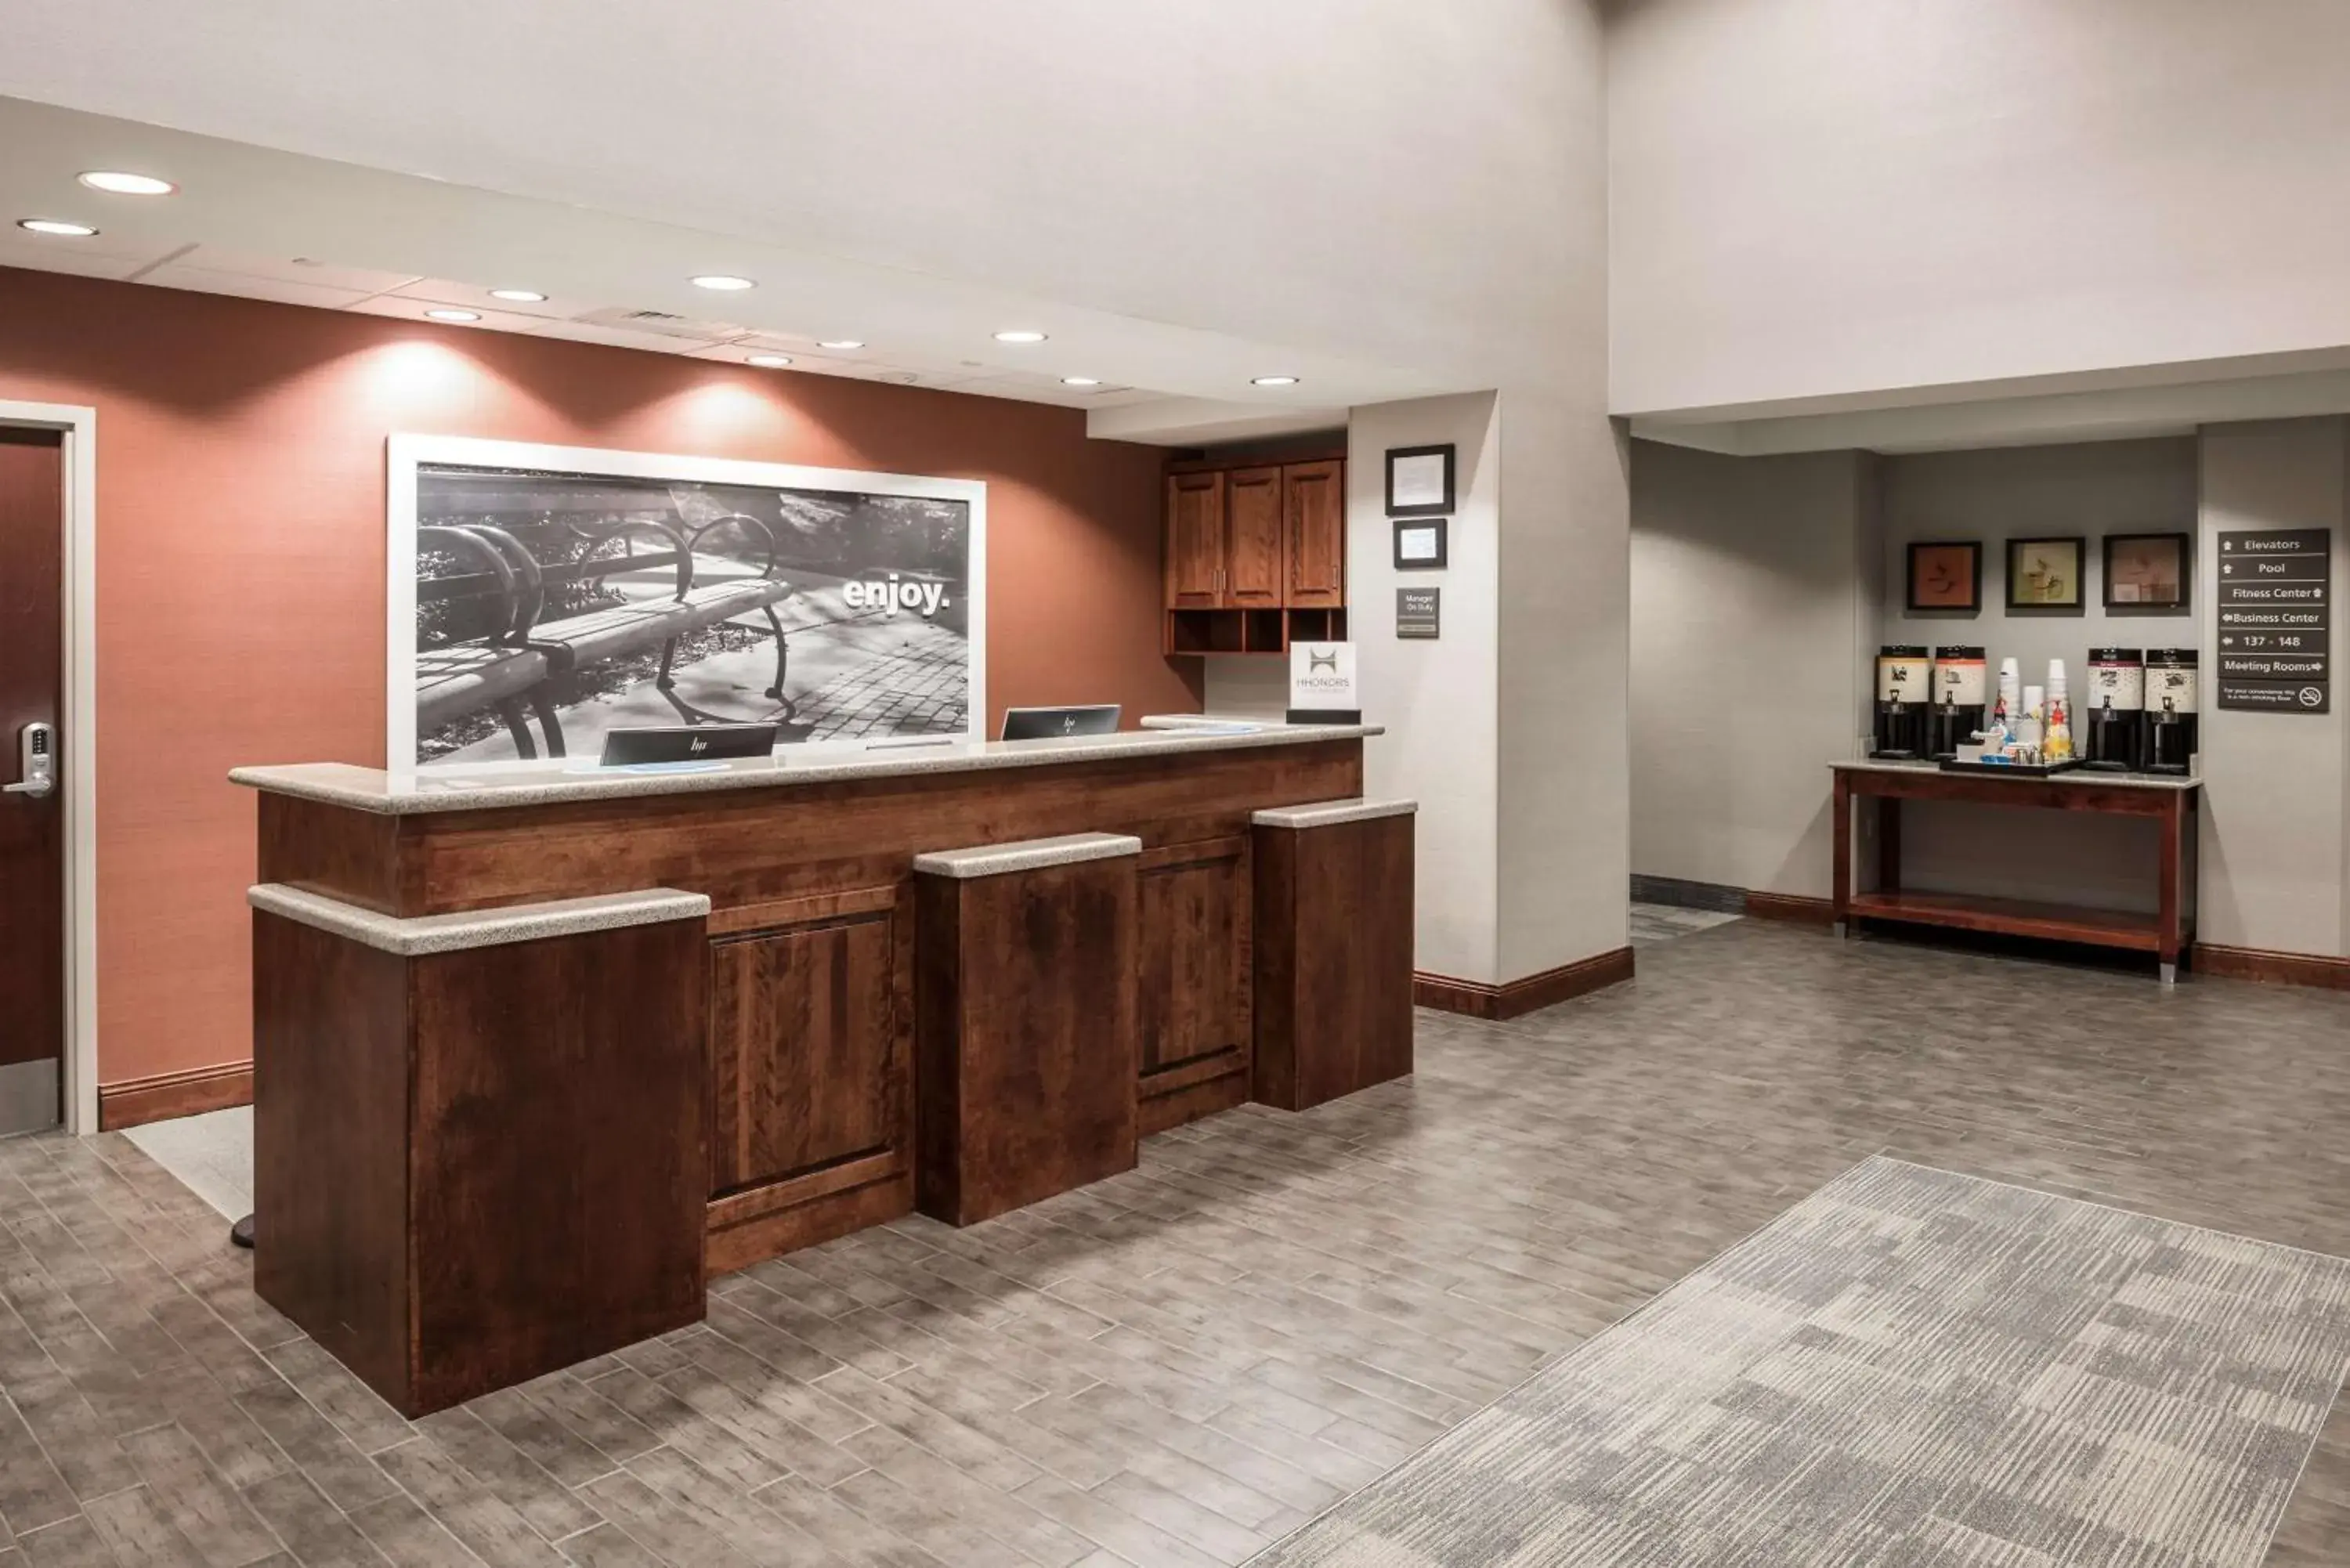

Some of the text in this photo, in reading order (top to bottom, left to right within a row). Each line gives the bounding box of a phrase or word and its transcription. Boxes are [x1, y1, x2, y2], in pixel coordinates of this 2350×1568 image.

[2244, 540, 2301, 550] Elevators
[2258, 563, 2285, 573] Pool
[843, 573, 951, 616] enjoy.
[2232, 588, 2312, 598] Fitness Center
[2233, 613, 2319, 623] Business Center
[2243, 636, 2265, 646] 137
[2279, 636, 2301, 646] 148
[2225, 660, 2312, 673] Meeting Rooms
[690, 736, 707, 757] hp
